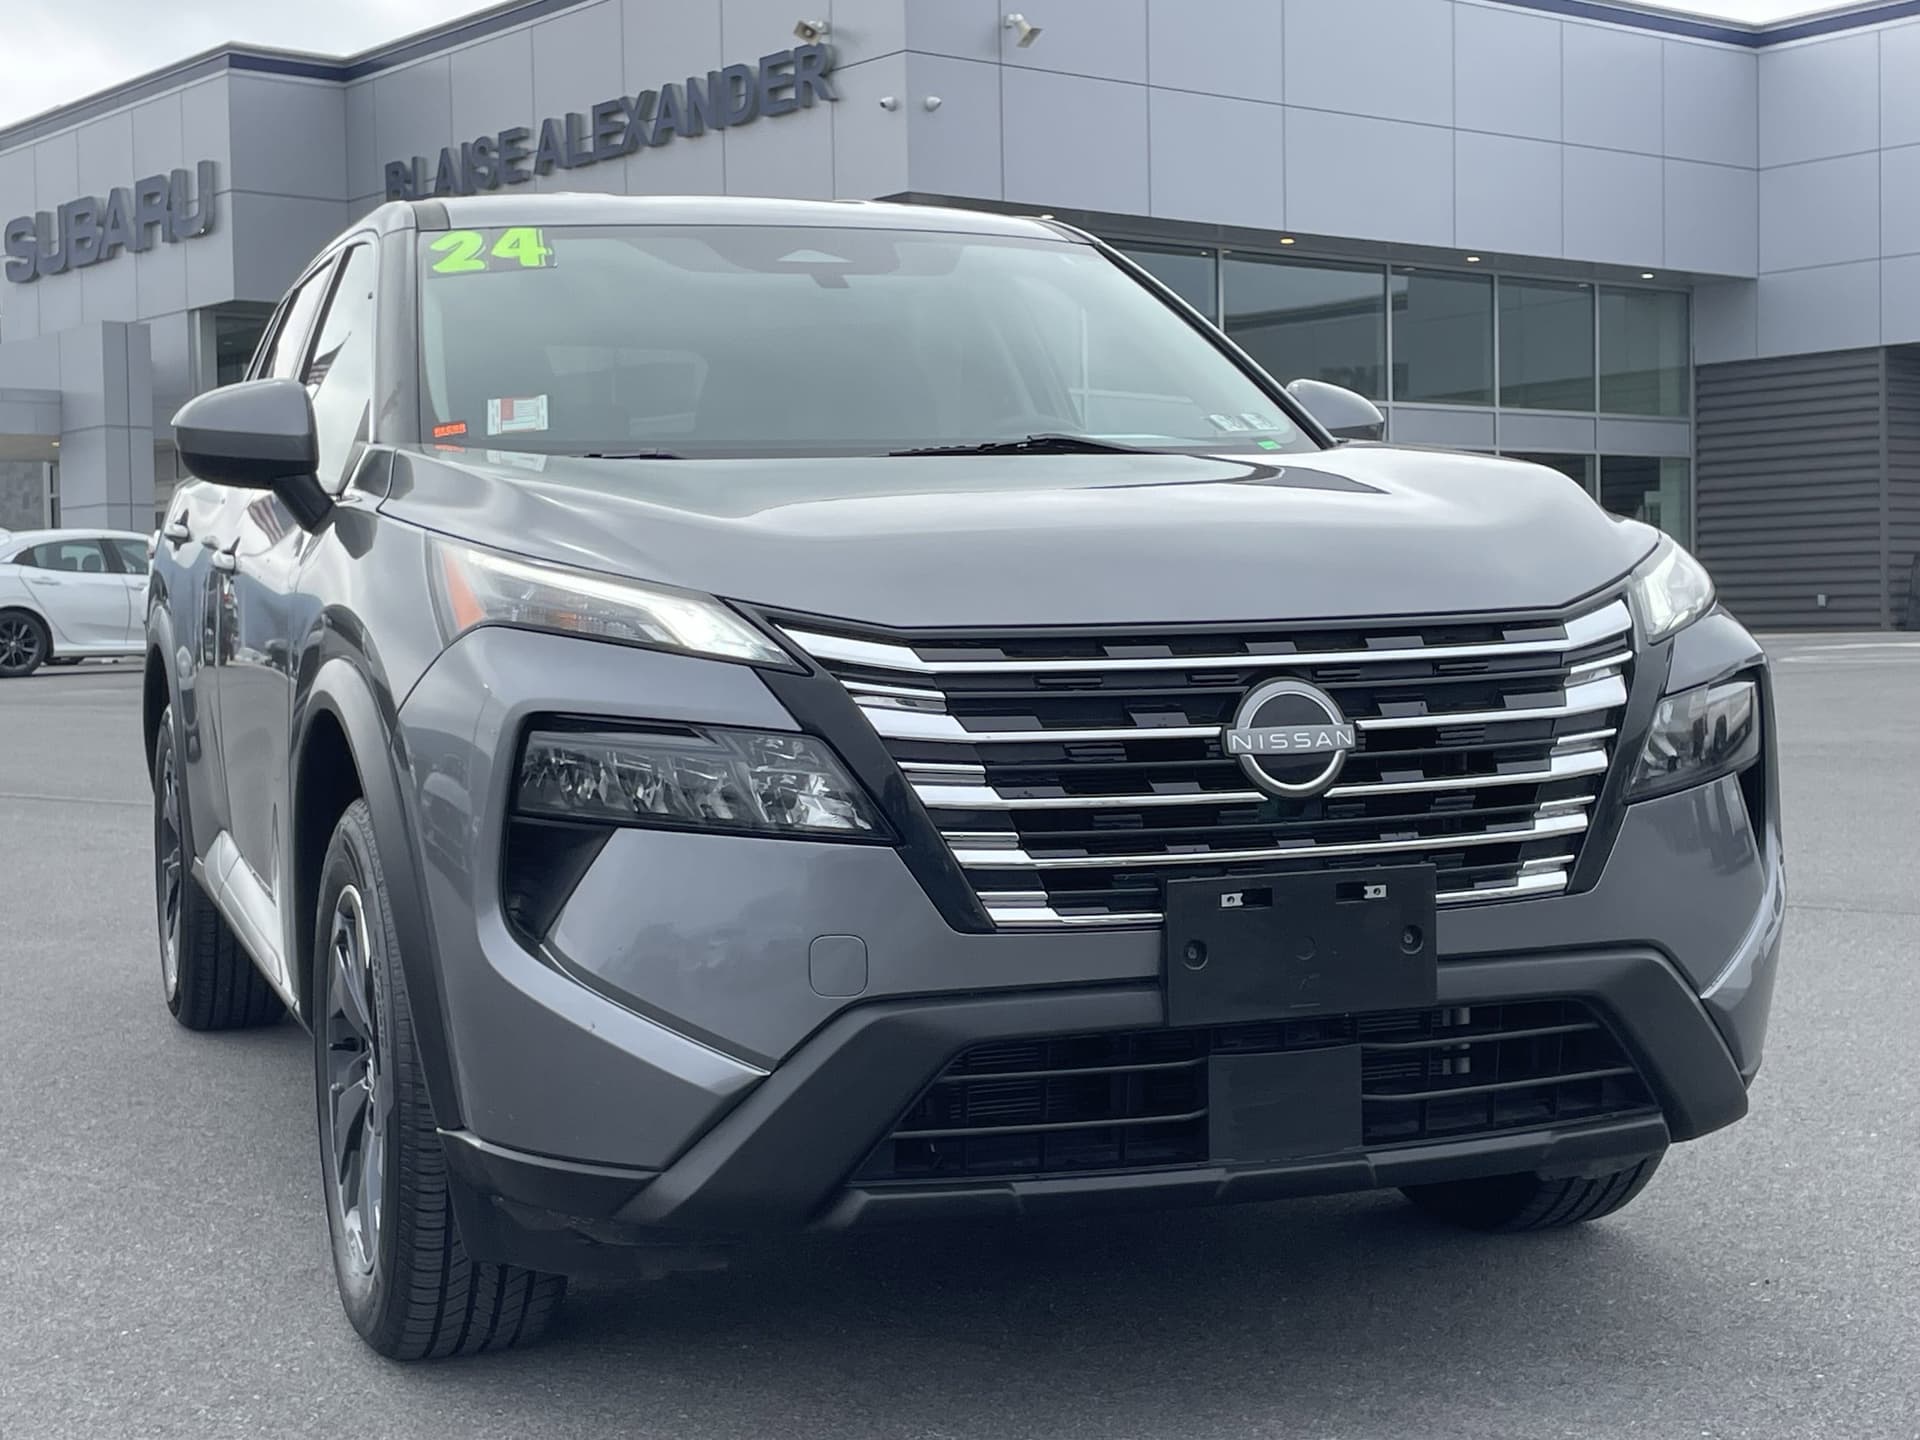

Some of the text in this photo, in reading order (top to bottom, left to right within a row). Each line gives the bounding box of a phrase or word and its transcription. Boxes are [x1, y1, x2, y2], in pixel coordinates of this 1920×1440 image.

[385, 42, 839, 201] BLAISE ALEXANDER
[4, 160, 216, 283] SUBARU
[429, 227, 552, 273] 24
[1231, 729, 1353, 750] NISSAN
